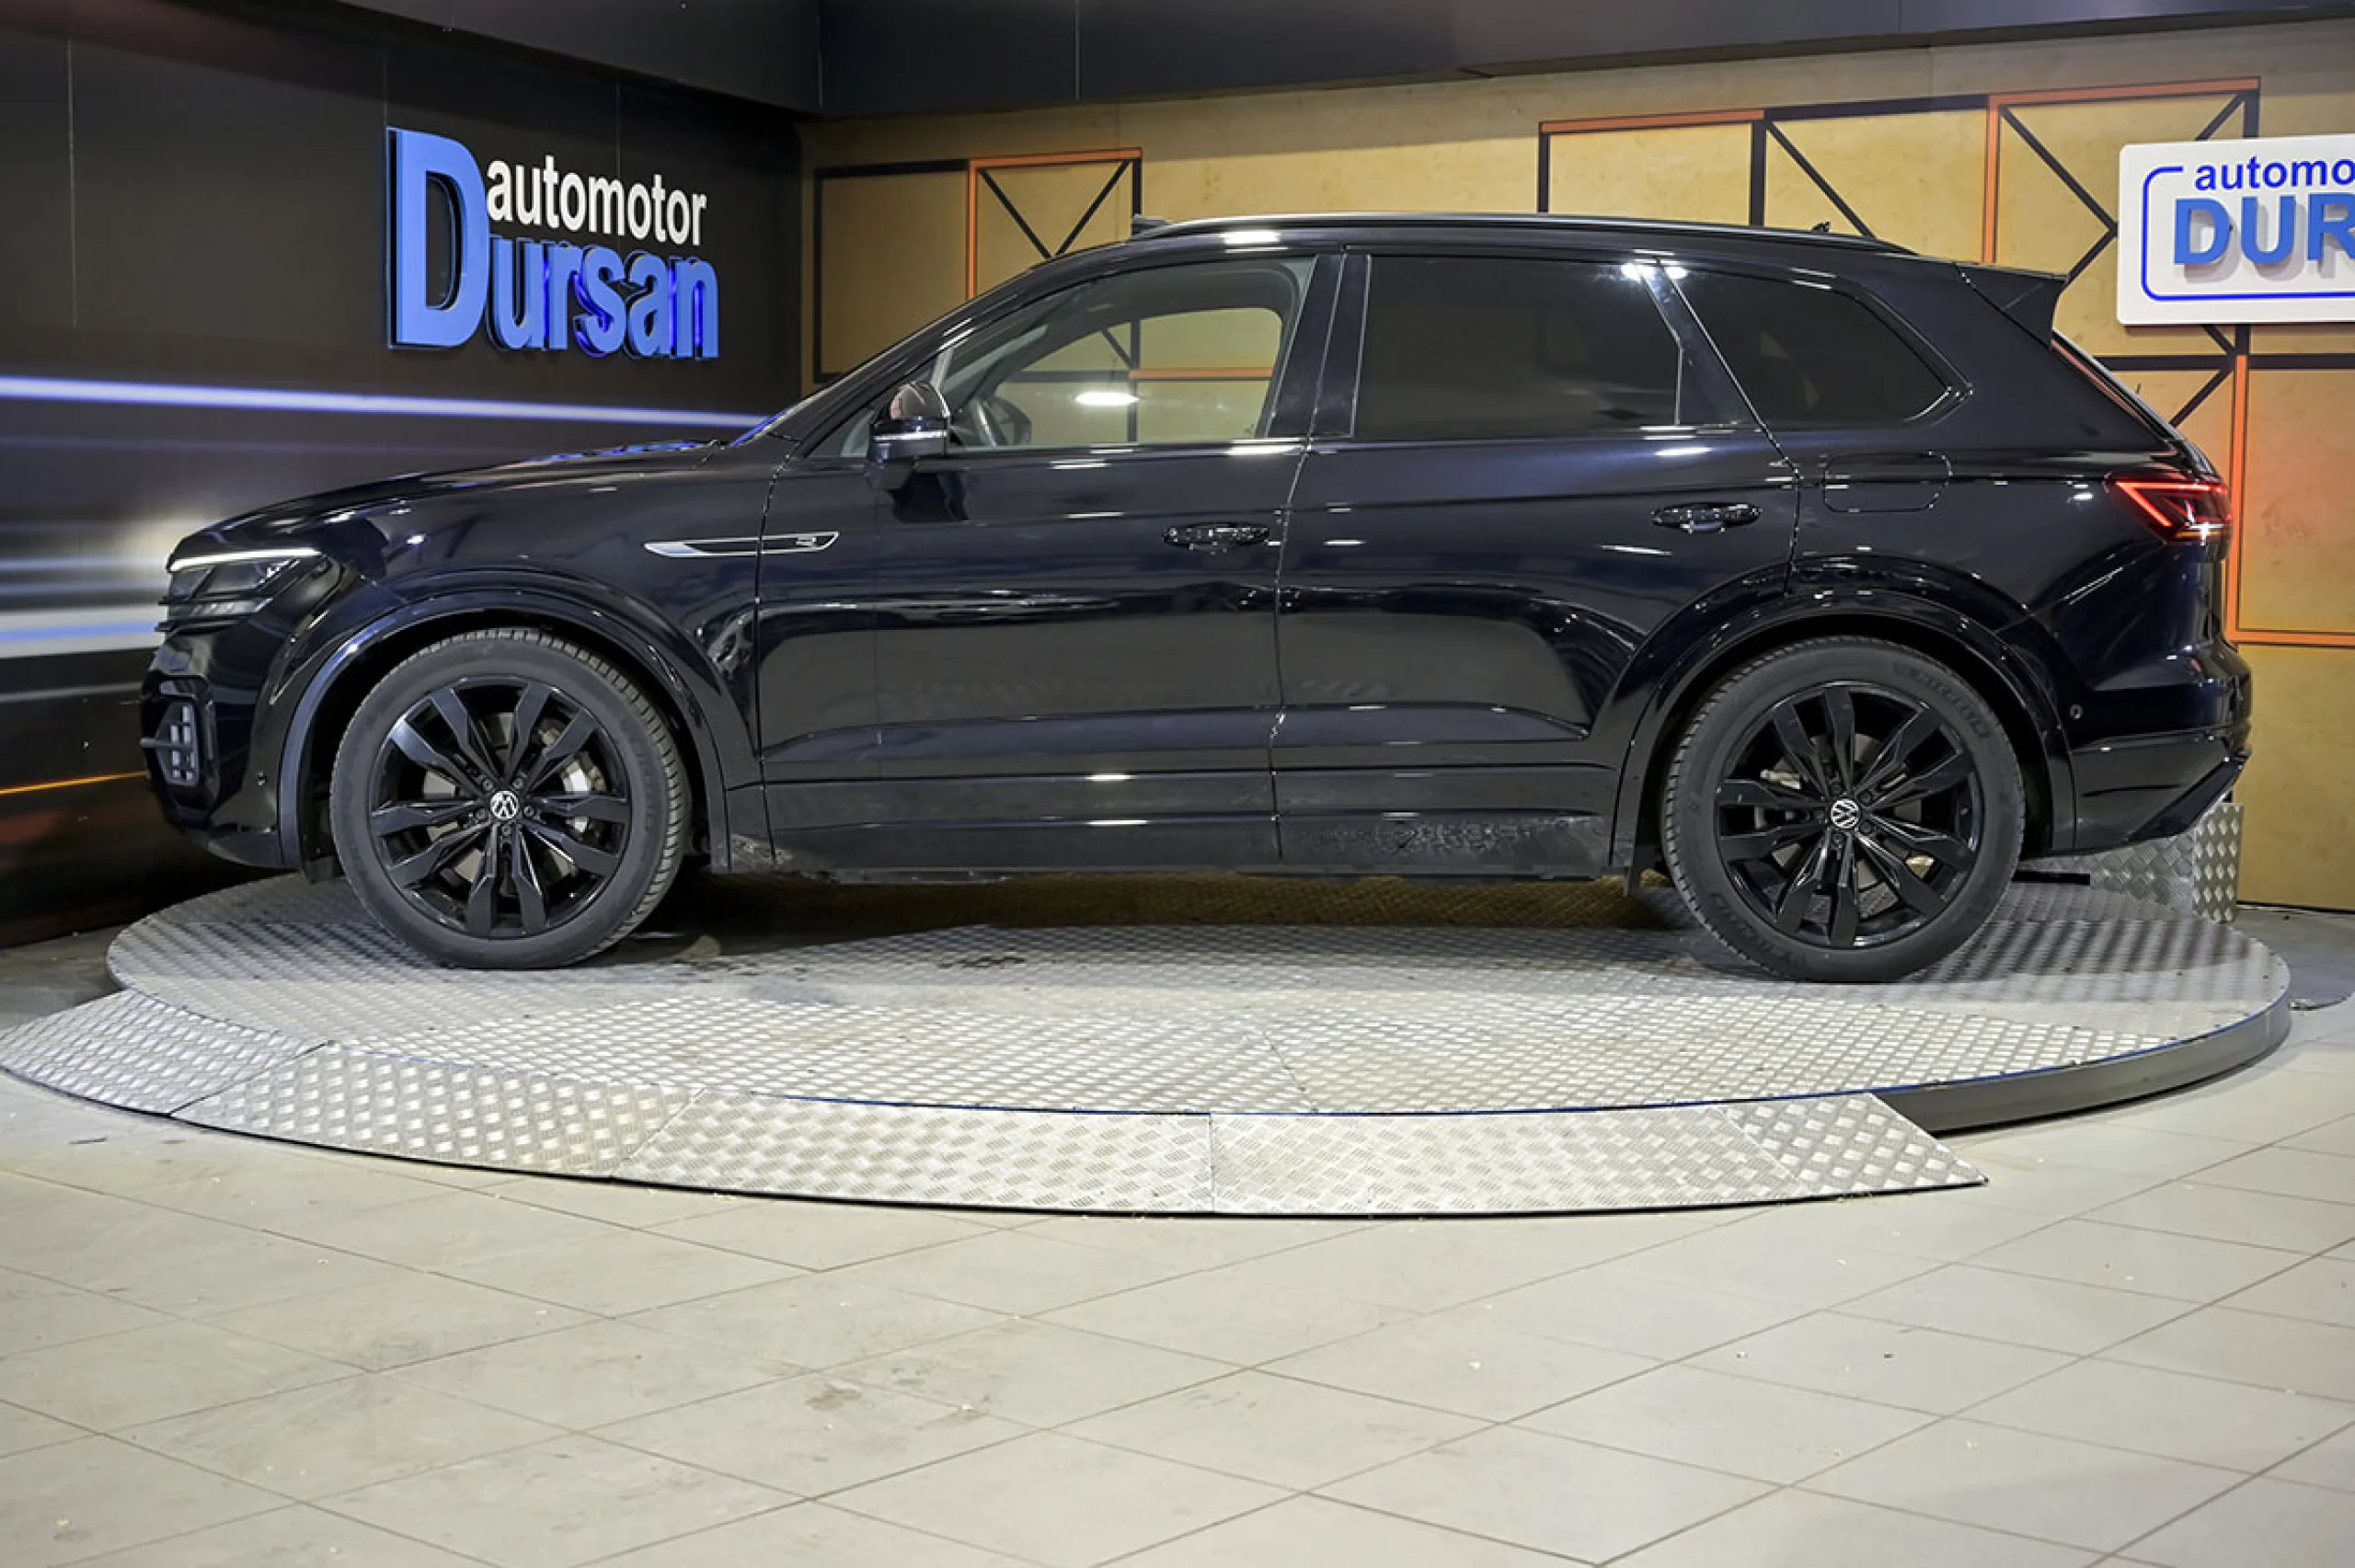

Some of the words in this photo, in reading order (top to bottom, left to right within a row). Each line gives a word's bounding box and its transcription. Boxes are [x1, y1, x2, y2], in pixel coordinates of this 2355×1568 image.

[488, 155, 707, 246] automotor
[2195, 155, 2355, 190] automo
[386, 125, 719, 360] Dursan
[2174, 192, 2355, 265] DUR
